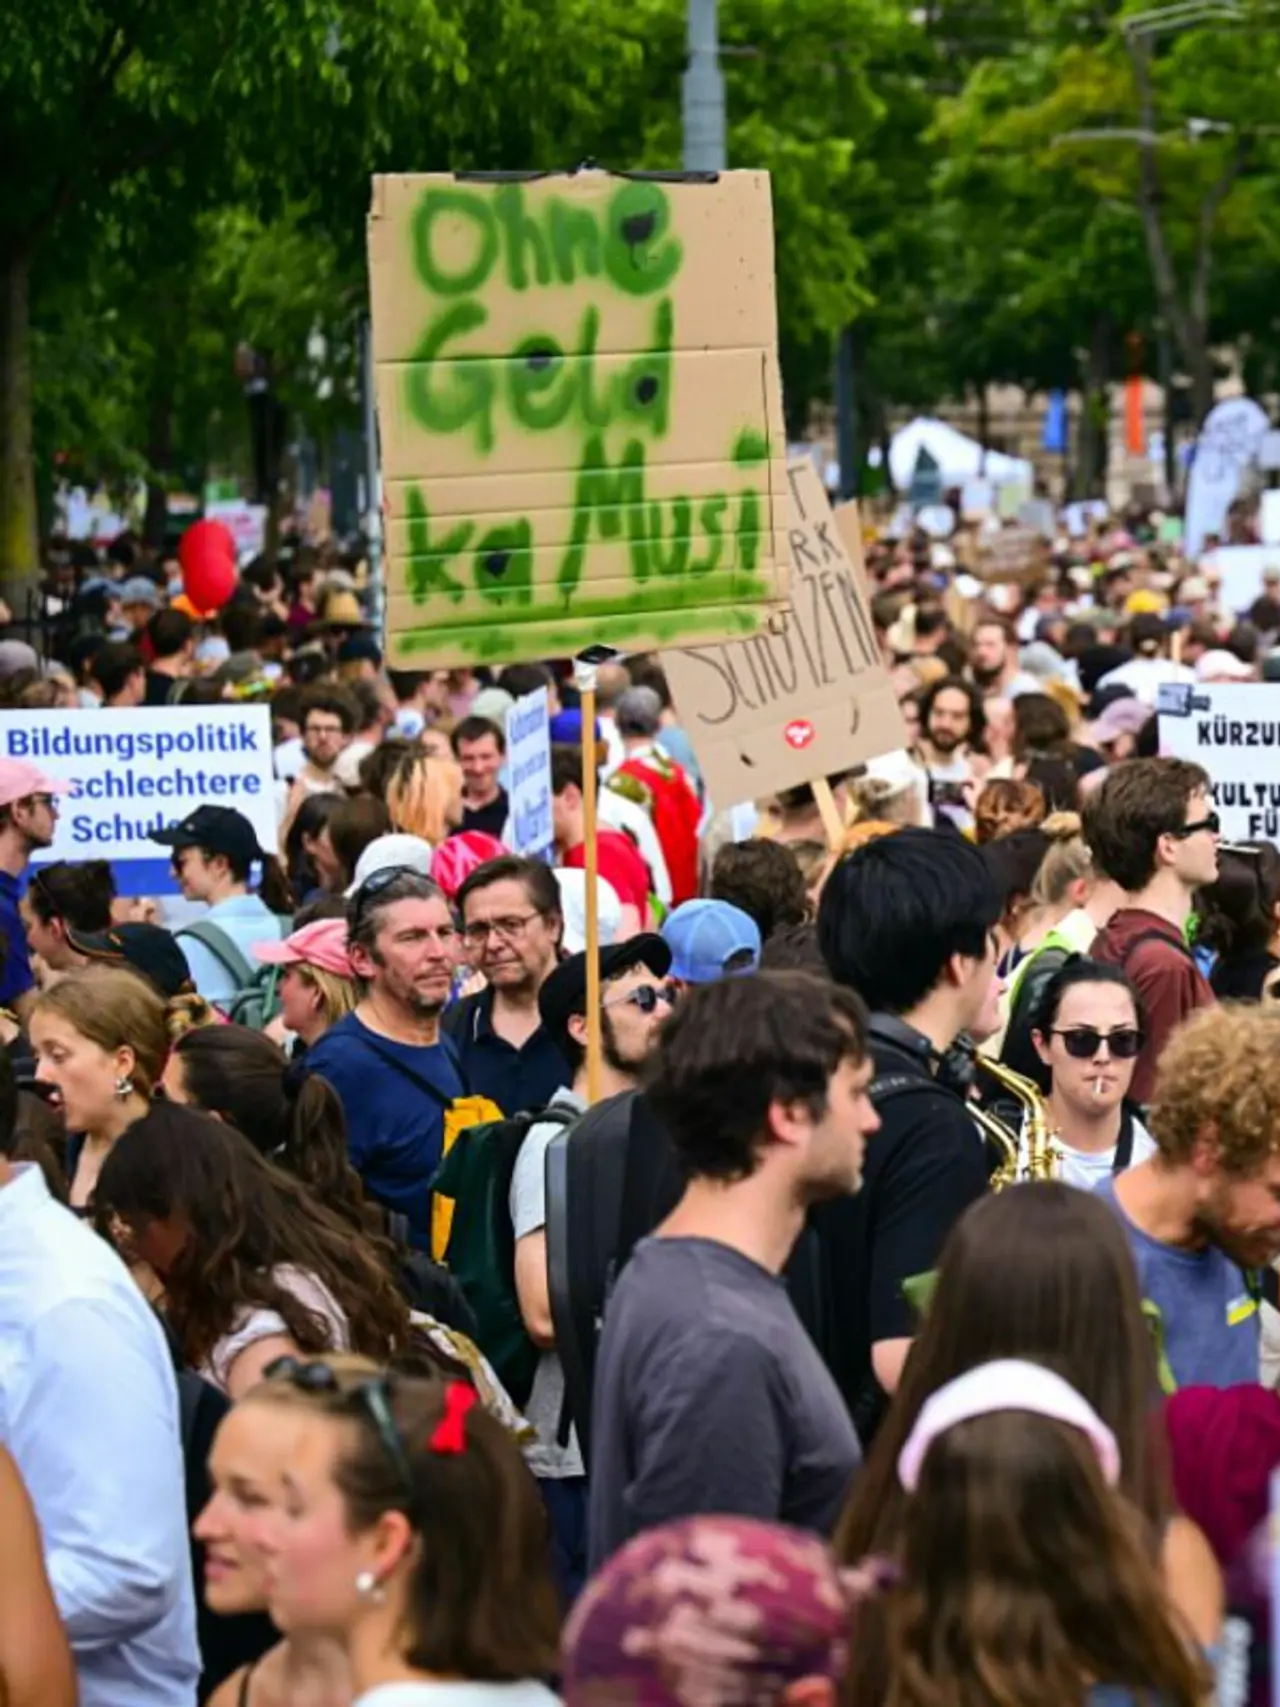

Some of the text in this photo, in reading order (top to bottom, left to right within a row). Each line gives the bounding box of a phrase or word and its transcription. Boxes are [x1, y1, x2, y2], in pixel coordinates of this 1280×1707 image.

[410, 182, 684, 297] Ohne
[405, 297, 674, 455] Geld
[405, 428, 771, 606] ka Musi
[7, 723, 259, 761] Bildungspolitik
[68, 767, 261, 799] schlechtere
